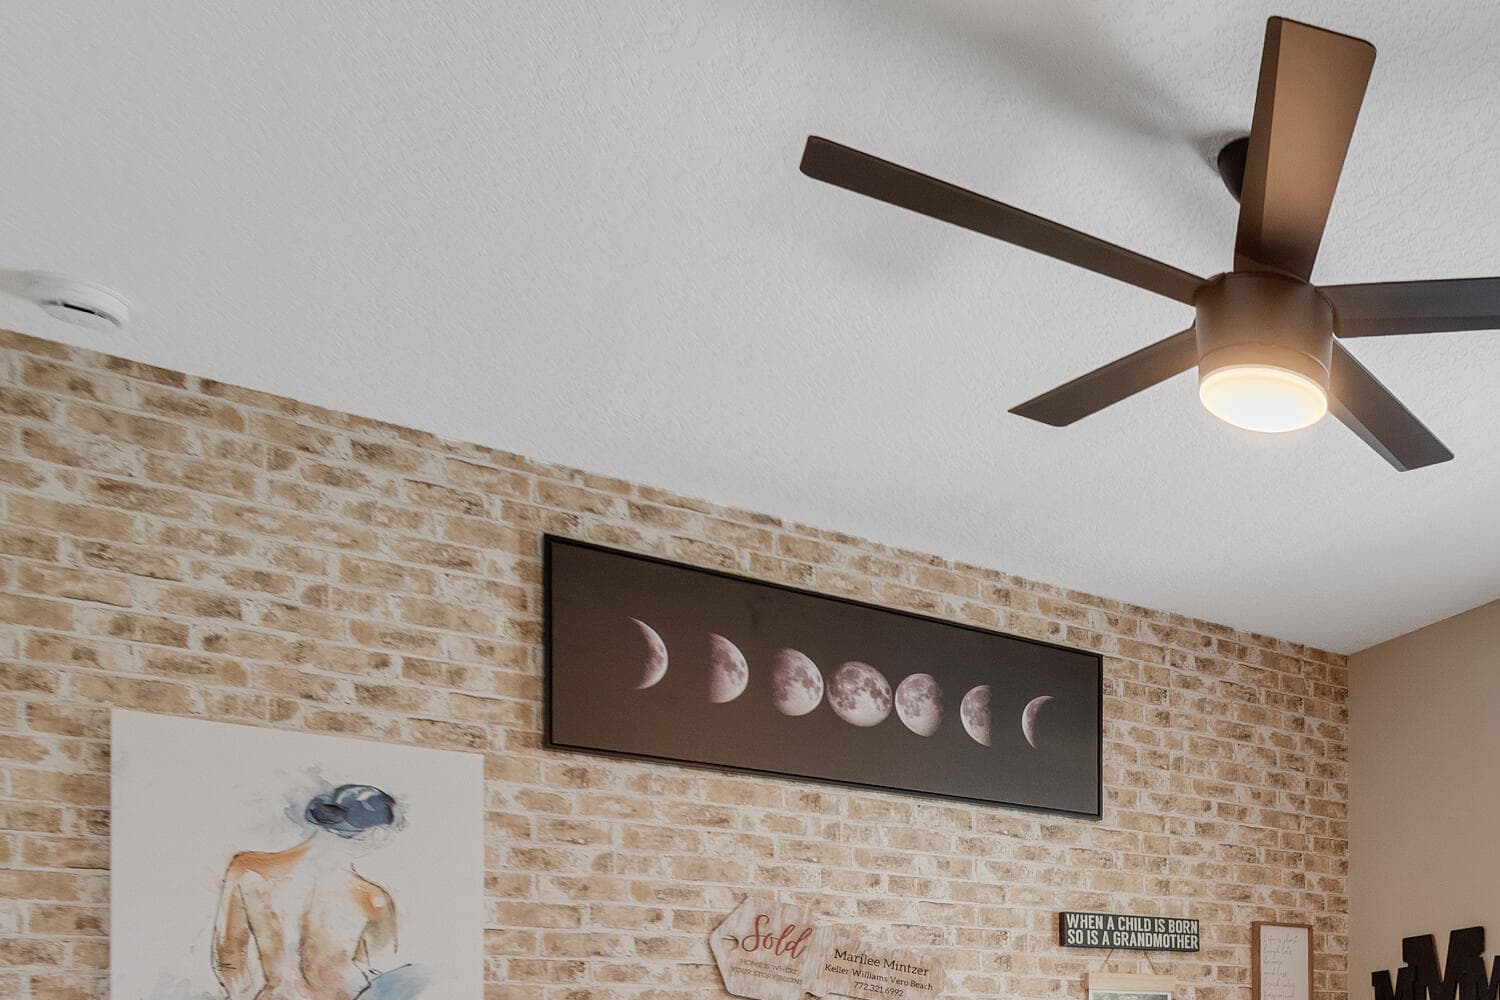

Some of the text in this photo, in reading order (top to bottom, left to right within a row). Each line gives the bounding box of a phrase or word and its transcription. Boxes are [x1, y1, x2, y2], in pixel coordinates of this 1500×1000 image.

[741, 914, 813, 960] Sold
[1066, 913, 1198, 935] WHEN A CHILD IS BORN
[1067, 929, 1199, 950] SO IS A GRANDMOTHER
[833, 948, 929, 977] Marilee Mintzer
[825, 963, 933, 991] Keller Williams Vero Beach
